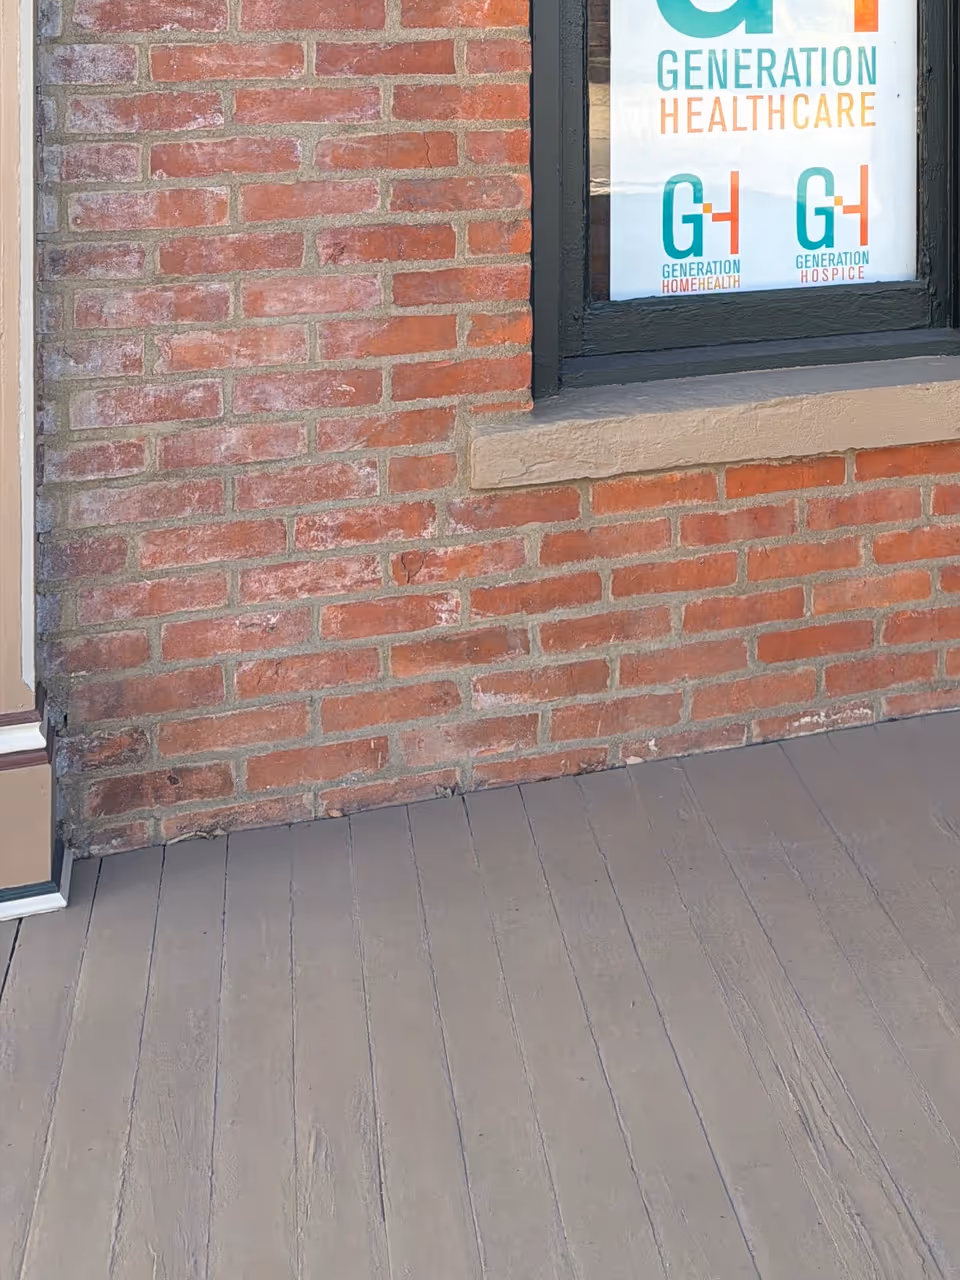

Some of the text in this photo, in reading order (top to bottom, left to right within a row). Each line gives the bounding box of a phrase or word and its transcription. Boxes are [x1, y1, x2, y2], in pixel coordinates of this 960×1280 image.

[656, 46, 878, 93] GENERATION
[659, 91, 877, 135] HEALTHCARE
[661, 170, 740, 260] GH
[795, 164, 869, 251] GH
[661, 259, 741, 279] GENERATION
[795, 250, 869, 269] GENERATION
[800, 266, 865, 283] HOSPICE
[660, 275, 741, 294] HOMEHEALTH
